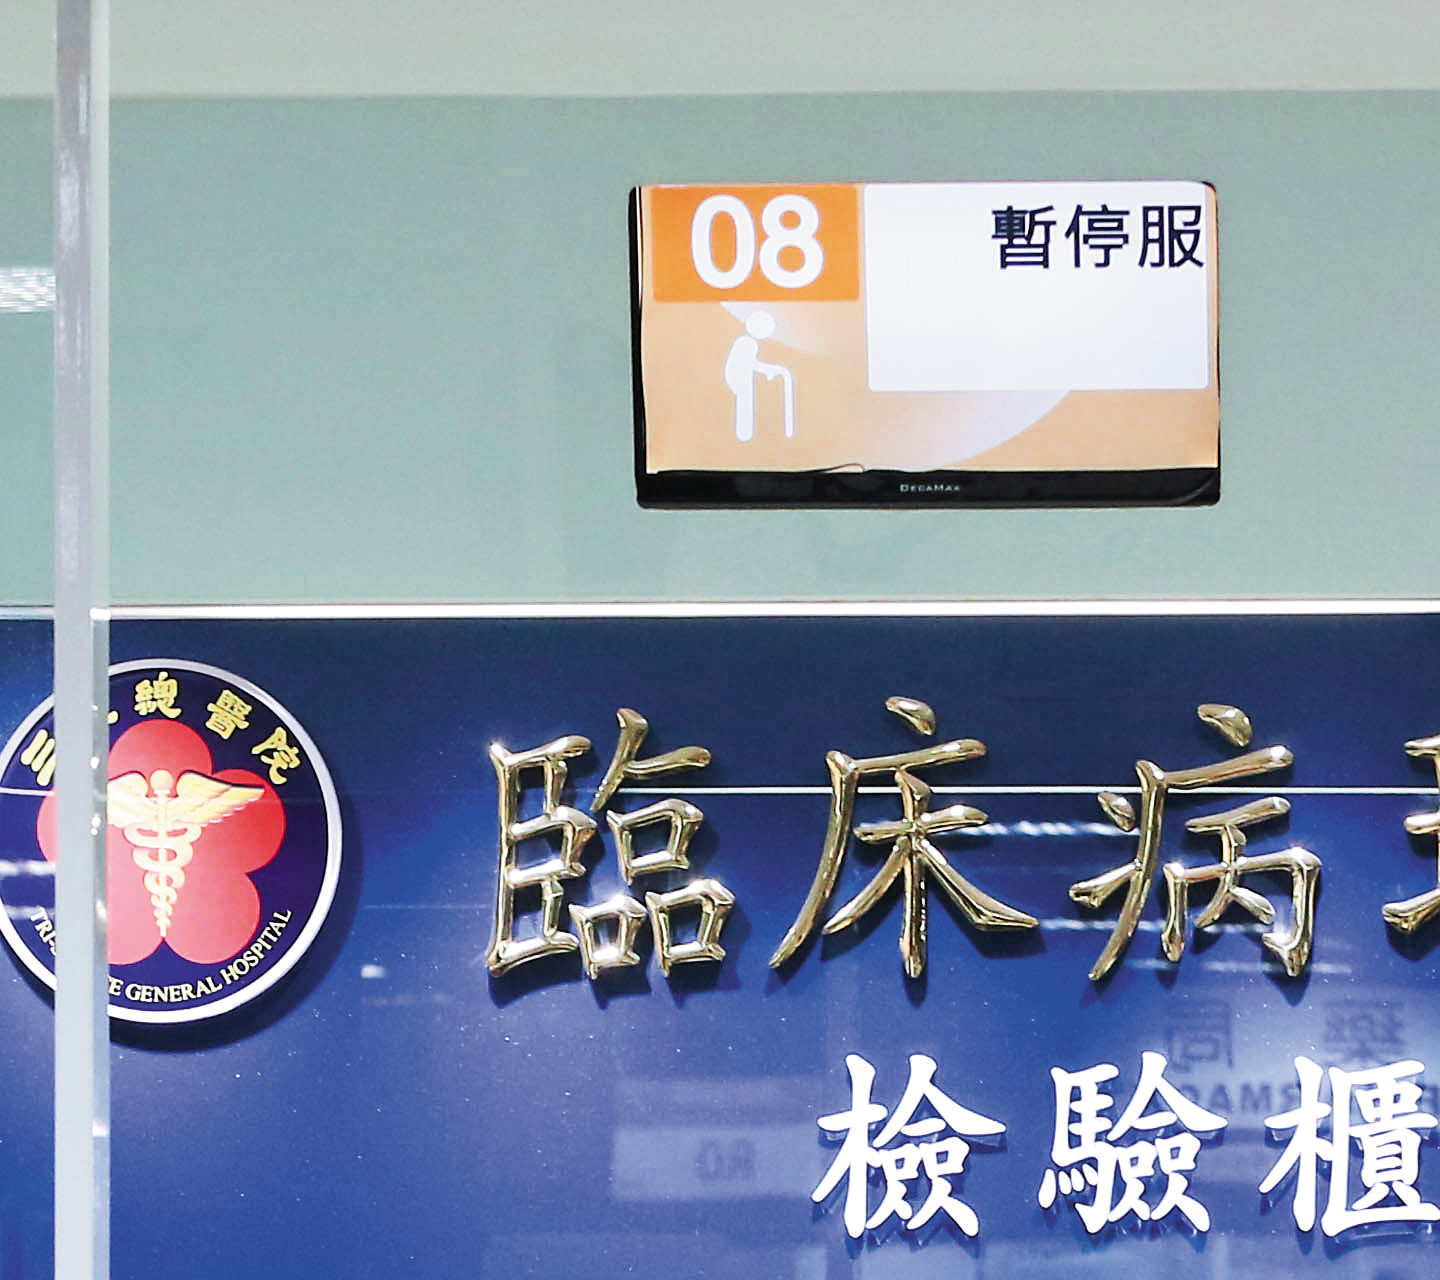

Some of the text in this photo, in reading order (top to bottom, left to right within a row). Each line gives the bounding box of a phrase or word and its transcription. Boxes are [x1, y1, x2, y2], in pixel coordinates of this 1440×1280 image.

[690, 194, 824, 290] 08
[991, 204, 1204, 269] 暫停服
[20, 670, 302, 786] 三總醫院
[125, 907, 293, 1004] GENERAL HOSPITAL
